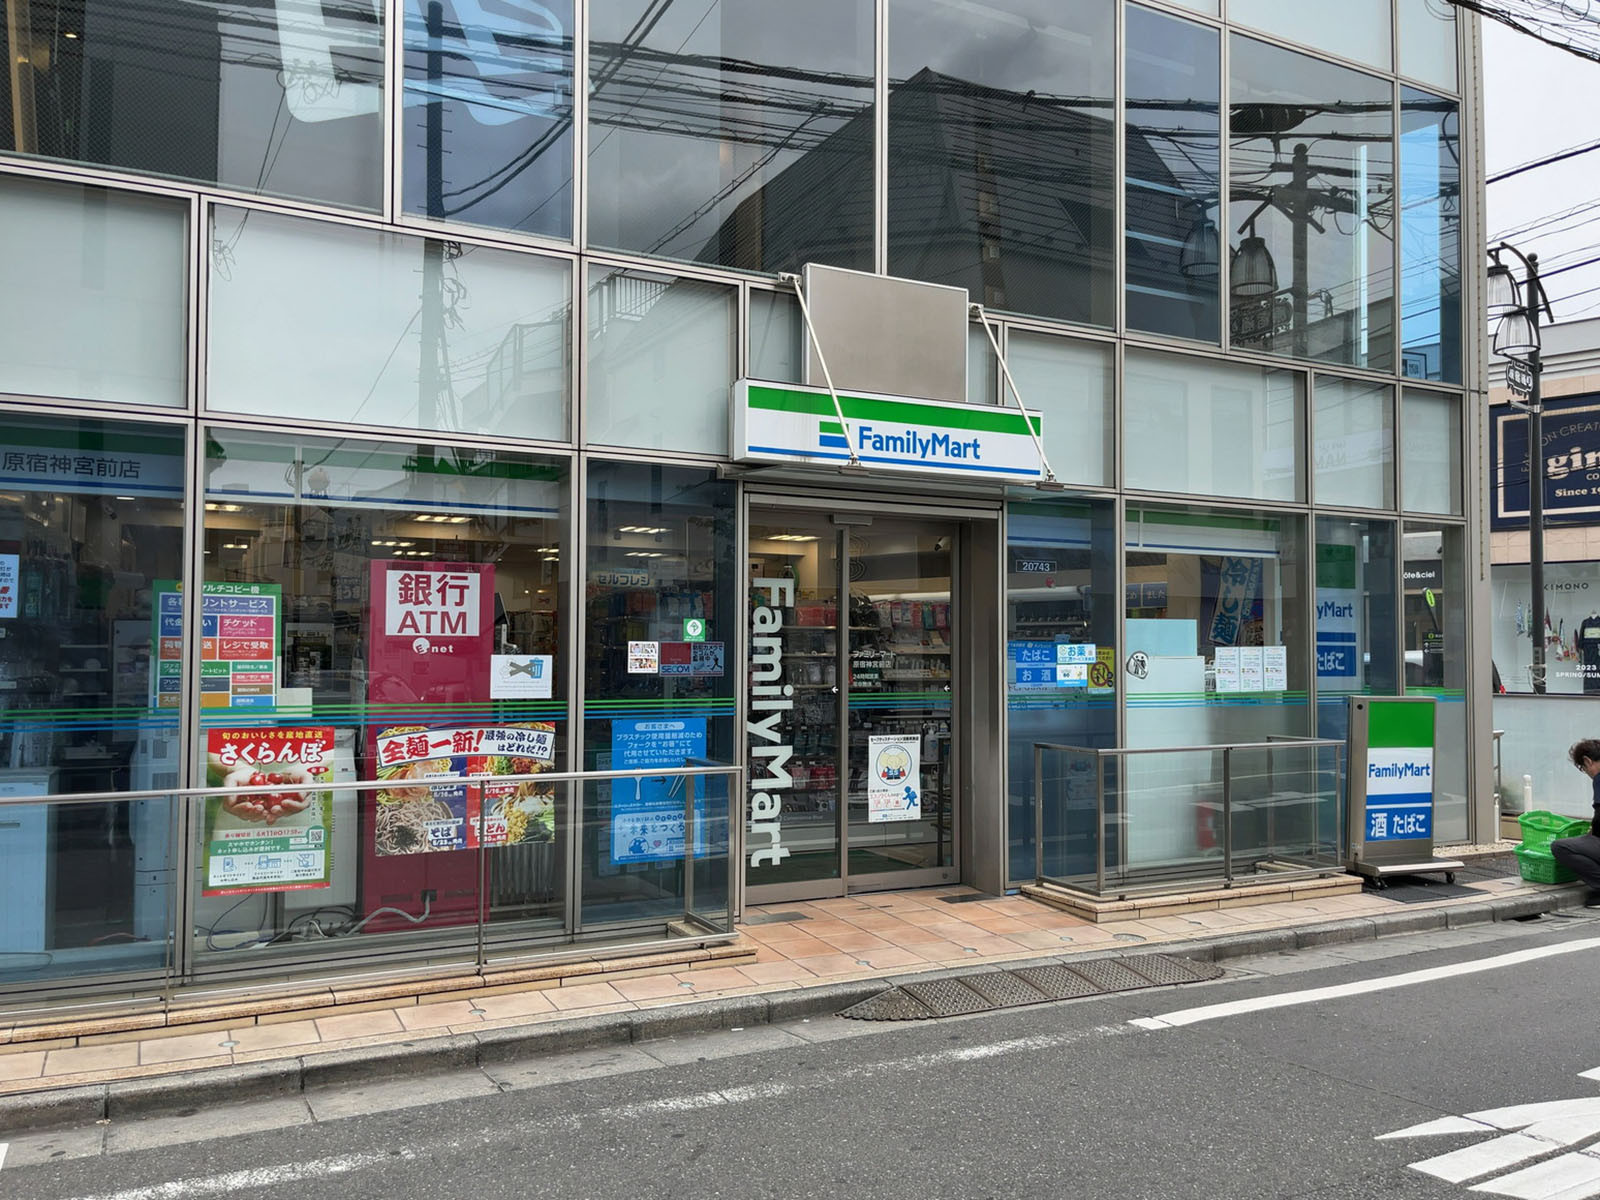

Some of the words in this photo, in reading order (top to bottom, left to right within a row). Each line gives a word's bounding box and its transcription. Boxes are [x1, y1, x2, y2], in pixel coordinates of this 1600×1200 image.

[858, 426, 981, 460] FamilyMart
[2, 452, 141, 479] 原宿神宮前店
[1555, 488, 1588, 497] Since
[1022, 561, 1051, 573] 20743
[398, 573, 470, 607] 銀行
[1316, 601, 1353, 620] yMart
[223, 618, 257, 627] チケット
[397, 610, 467, 634] ATM
[223, 640, 269, 650] レジで受取
[1067, 645, 1086, 657] お薬
[852, 650, 897, 659] ファミリーマート
[1021, 648, 1051, 662] たばこ
[661, 665, 691, 673] SECOM
[747, 577, 794, 868] FamilyMart
[222, 730, 323, 740] 旬のおいしさを産地直送
[220, 739, 327, 766] さくらんぼ
[381, 729, 485, 764] 全麺一新!
[485, 730, 548, 745] 最強の冷し麺
[1368, 763, 1431, 779] FamilyMart
[430, 826, 452, 838] そば
[1371, 811, 1388, 838] 酒
[1392, 812, 1426, 834] たばこ
